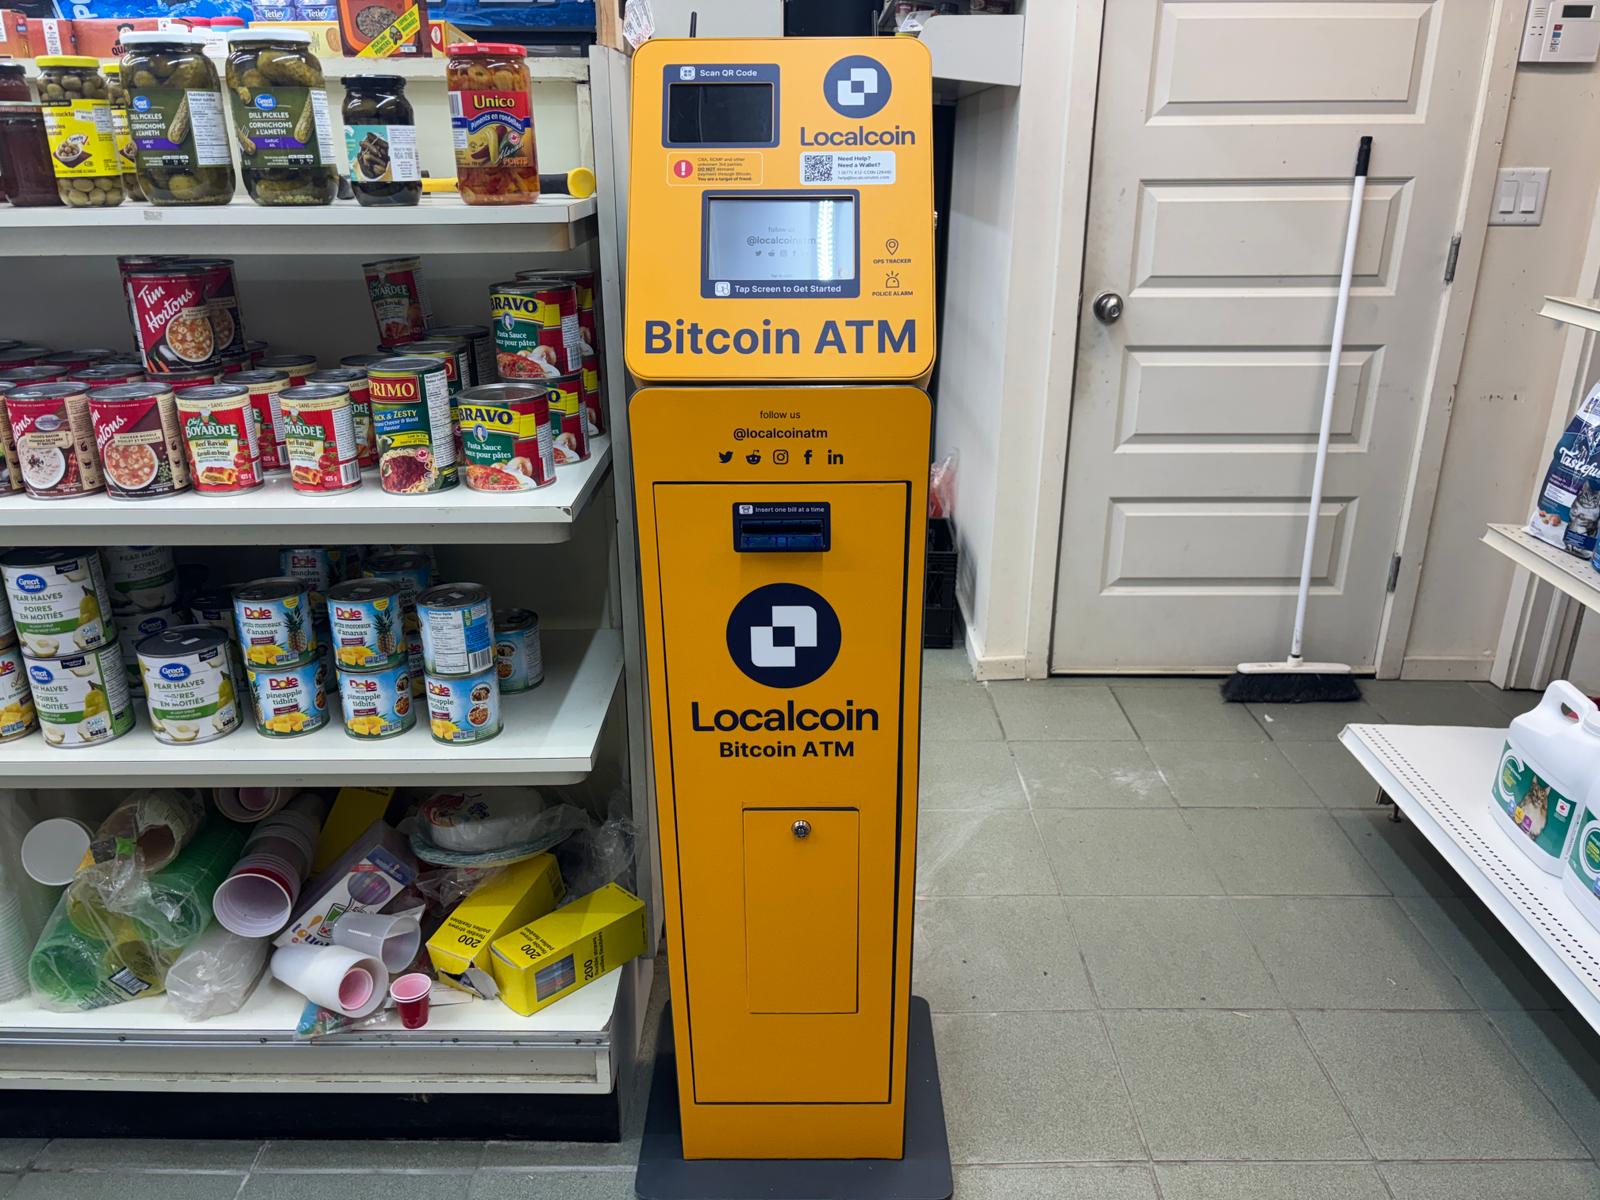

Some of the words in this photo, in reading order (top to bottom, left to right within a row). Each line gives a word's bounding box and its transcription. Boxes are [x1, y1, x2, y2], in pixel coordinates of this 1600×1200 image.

[263, 10, 285, 19] Tetley
[307, 9, 328, 18] Tetley
[700, 69, 720, 77] Scan
[721, 69, 734, 77] QR
[736, 69, 757, 77] Code
[473, 95, 516, 109] Unico
[248, 121, 293, 129] CORNICHONS
[800, 125, 915, 146] Localcoin
[735, 285, 750, 295] Tap
[752, 285, 781, 294] Screen
[793, 285, 808, 293] Get
[810, 284, 842, 293] Started
[138, 285, 166, 308] Tim
[144, 288, 193, 334] Hortons
[490, 297, 538, 313] BRAVO
[509, 331, 528, 339] Sauce
[644, 318, 801, 355] Bitcoin
[814, 318, 917, 354] ATM
[504, 340, 517, 348] pour
[518, 339, 536, 348] pâtes
[368, 379, 415, 398] PRIMO
[392, 409, 417, 419] ZESTY
[458, 407, 513, 425] BRAVO
[760, 410, 787, 419] follow
[185, 423, 239, 439] BOYARDEE
[733, 427, 828, 442] @localcoinatm
[481, 443, 502, 451] Sauce
[476, 451, 492, 459] pour
[492, 451, 512, 460] pâtes
[1559, 446, 1600, 479] Tastefu
[291, 555, 317, 566] Dole
[30, 591, 64, 601] HALVES
[23, 604, 53, 613] POIRES
[244, 606, 272, 619] Dole
[335, 606, 362, 619] Dole
[30, 610, 64, 621] MOITIÉS
[153, 682, 172, 690] PEAR
[173, 678, 205, 689] HALVES
[269, 676, 299, 690] Dole
[349, 679, 377, 691] Dole
[428, 681, 451, 695] Dole
[266, 688, 303, 701] pineapple
[272, 697, 298, 706] tidbits
[352, 699, 376, 708] tidbits
[691, 699, 879, 732] Localcoin
[719, 741, 796, 758] Bitcoin
[802, 741, 854, 757] ATM
[457, 934, 482, 949] 200
[520, 944, 542, 960] 200
[583, 959, 594, 981] 200
